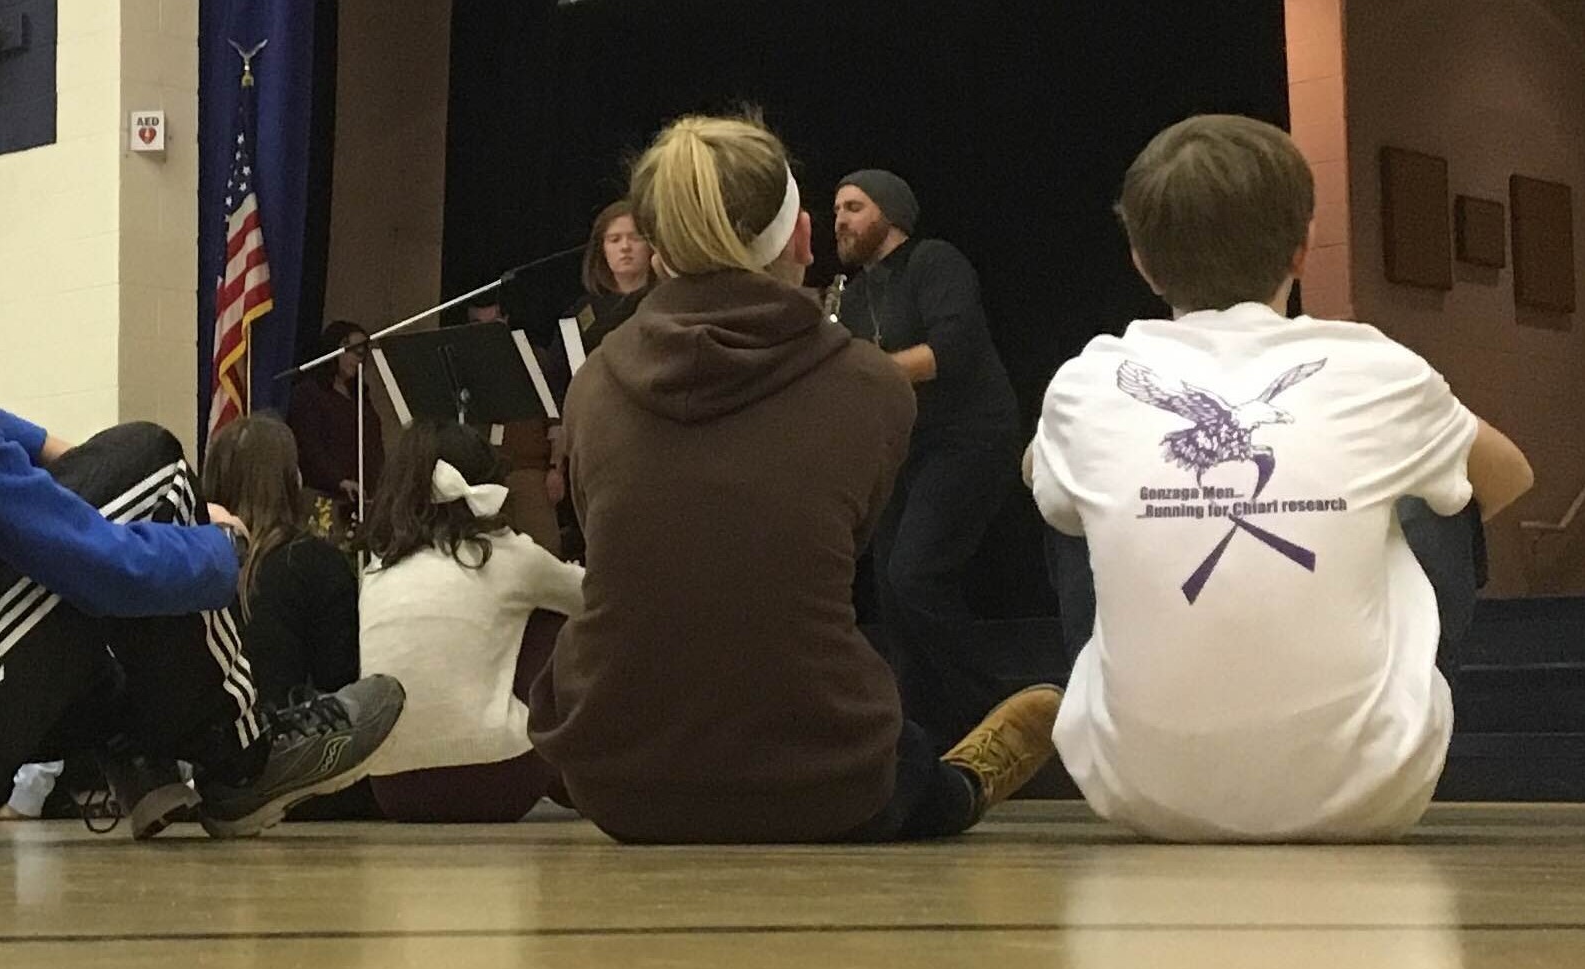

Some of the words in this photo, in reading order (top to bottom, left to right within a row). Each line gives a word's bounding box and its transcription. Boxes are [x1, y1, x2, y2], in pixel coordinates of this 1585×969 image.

[136, 116, 160, 127] AED
[1140, 486, 1199, 501] Gonzaga
[1208, 501, 1229, 518] for
[1232, 500, 1279, 516] Chiari
[1282, 497, 1347, 512] research
